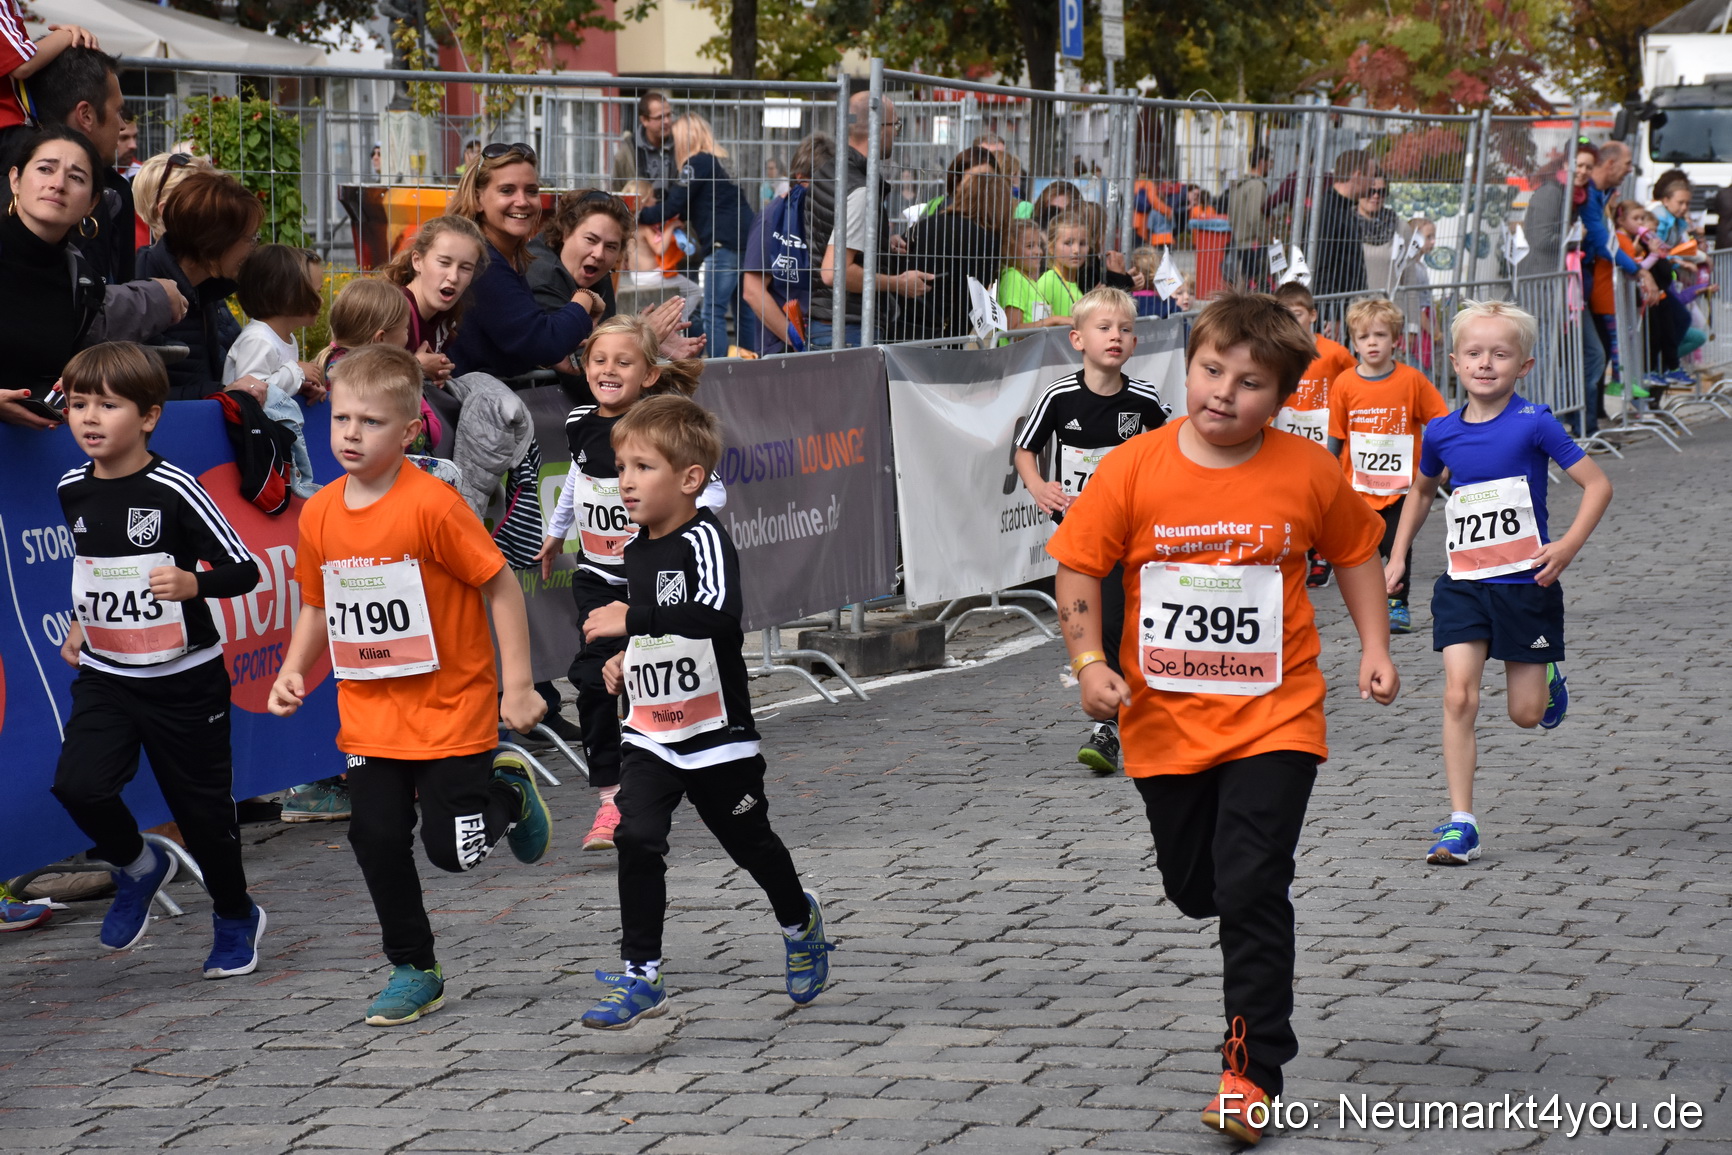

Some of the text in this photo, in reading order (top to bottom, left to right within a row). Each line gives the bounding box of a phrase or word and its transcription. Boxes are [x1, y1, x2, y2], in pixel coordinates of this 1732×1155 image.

[717, 439, 794, 486] NDUSTRY
[1358, 451, 1402, 472] 7225
[1467, 489, 1499, 503] BOCK
[583, 502, 634, 532] 706
[1154, 521, 1253, 538] Neumarkter
[1455, 508, 1520, 546] 7278
[137, 519, 158, 545] TSV
[1155, 540, 1233, 556] Stadtlauf
[101, 567, 139, 577] BOCK
[347, 577, 385, 588] BOCK
[523, 570, 577, 598] by sma
[1193, 577, 1242, 589] BOCK
[86, 588, 163, 622] 7243
[336, 599, 410, 636] 7190
[42, 609, 73, 646] ON
[1162, 602, 1260, 645] 7395
[641, 633, 674, 647] BOCK
[231, 642, 283, 687] SPORTS
[359, 648, 391, 660] Kilian
[1147, 649, 1264, 677] Sebastian
[631, 657, 700, 699] 7078
[652, 708, 684, 724] Philipp
[732, 800, 758, 815] adidas
